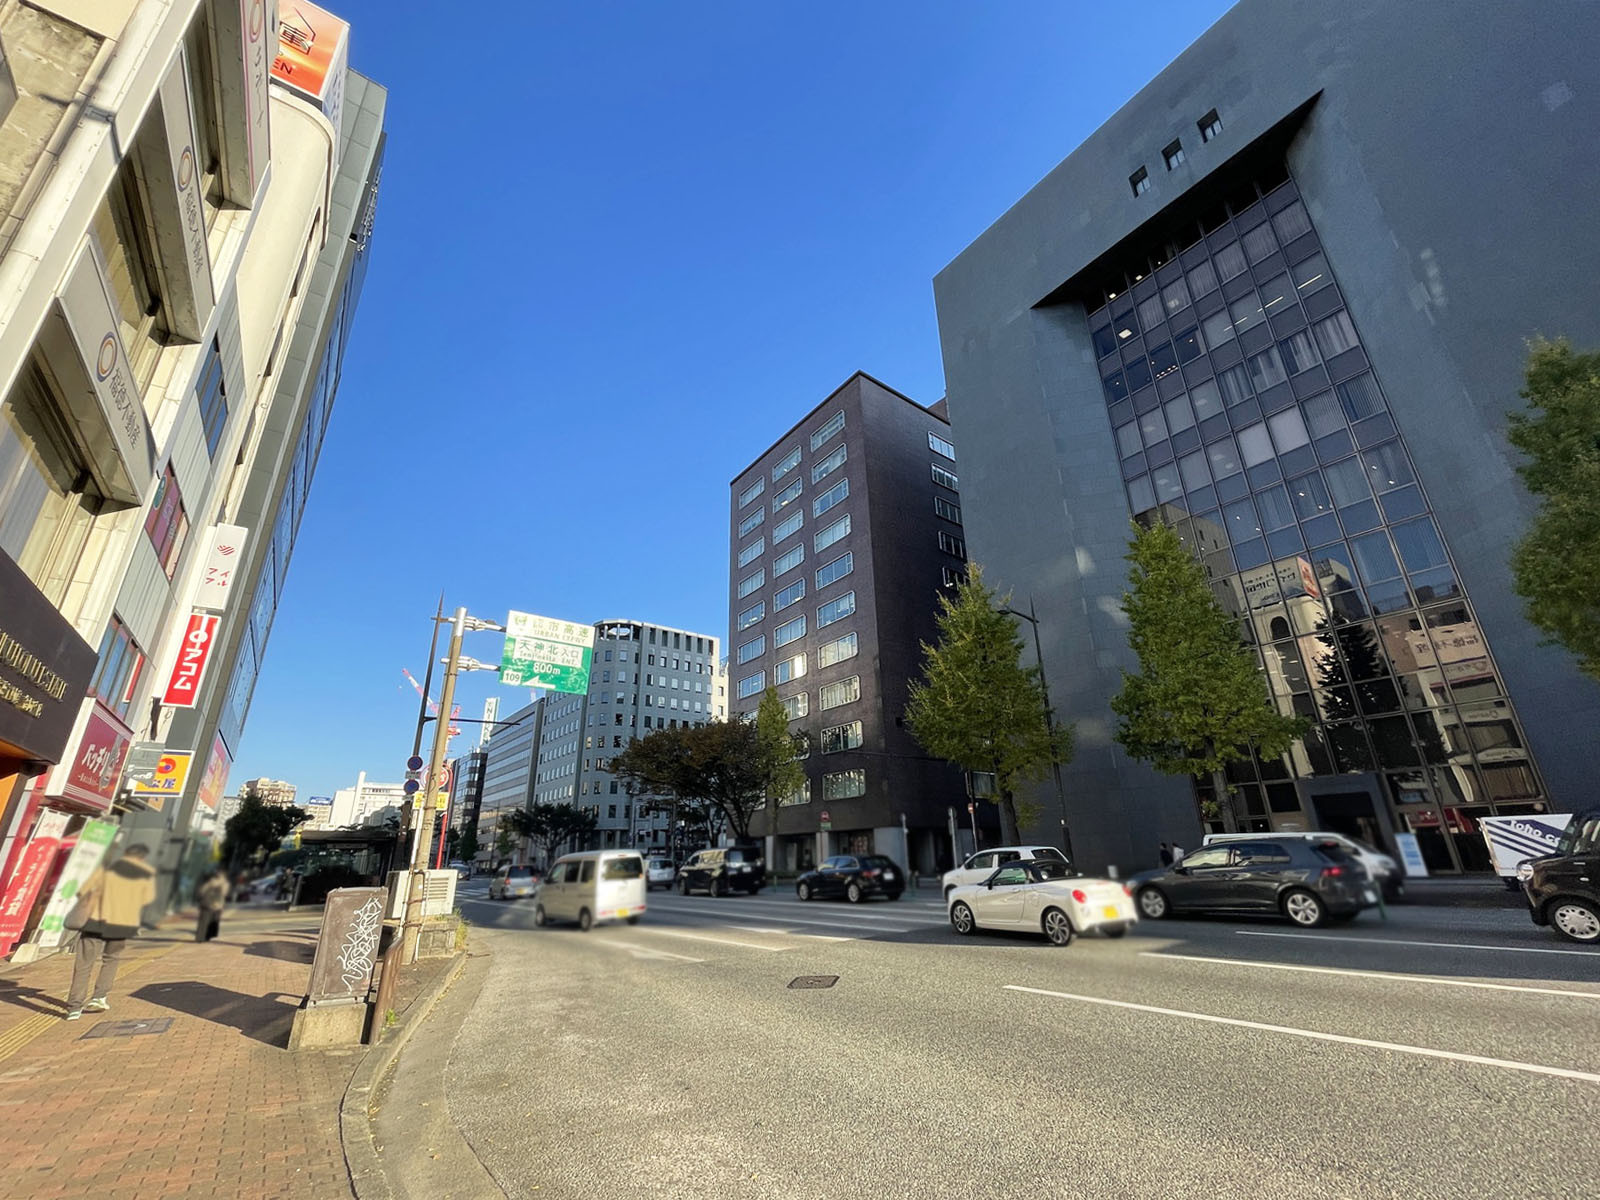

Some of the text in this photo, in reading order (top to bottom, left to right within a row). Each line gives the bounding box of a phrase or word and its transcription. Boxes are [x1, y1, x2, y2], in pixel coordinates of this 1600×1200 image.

[173, 647, 203, 691] アコム
[505, 672, 520, 682] 109
